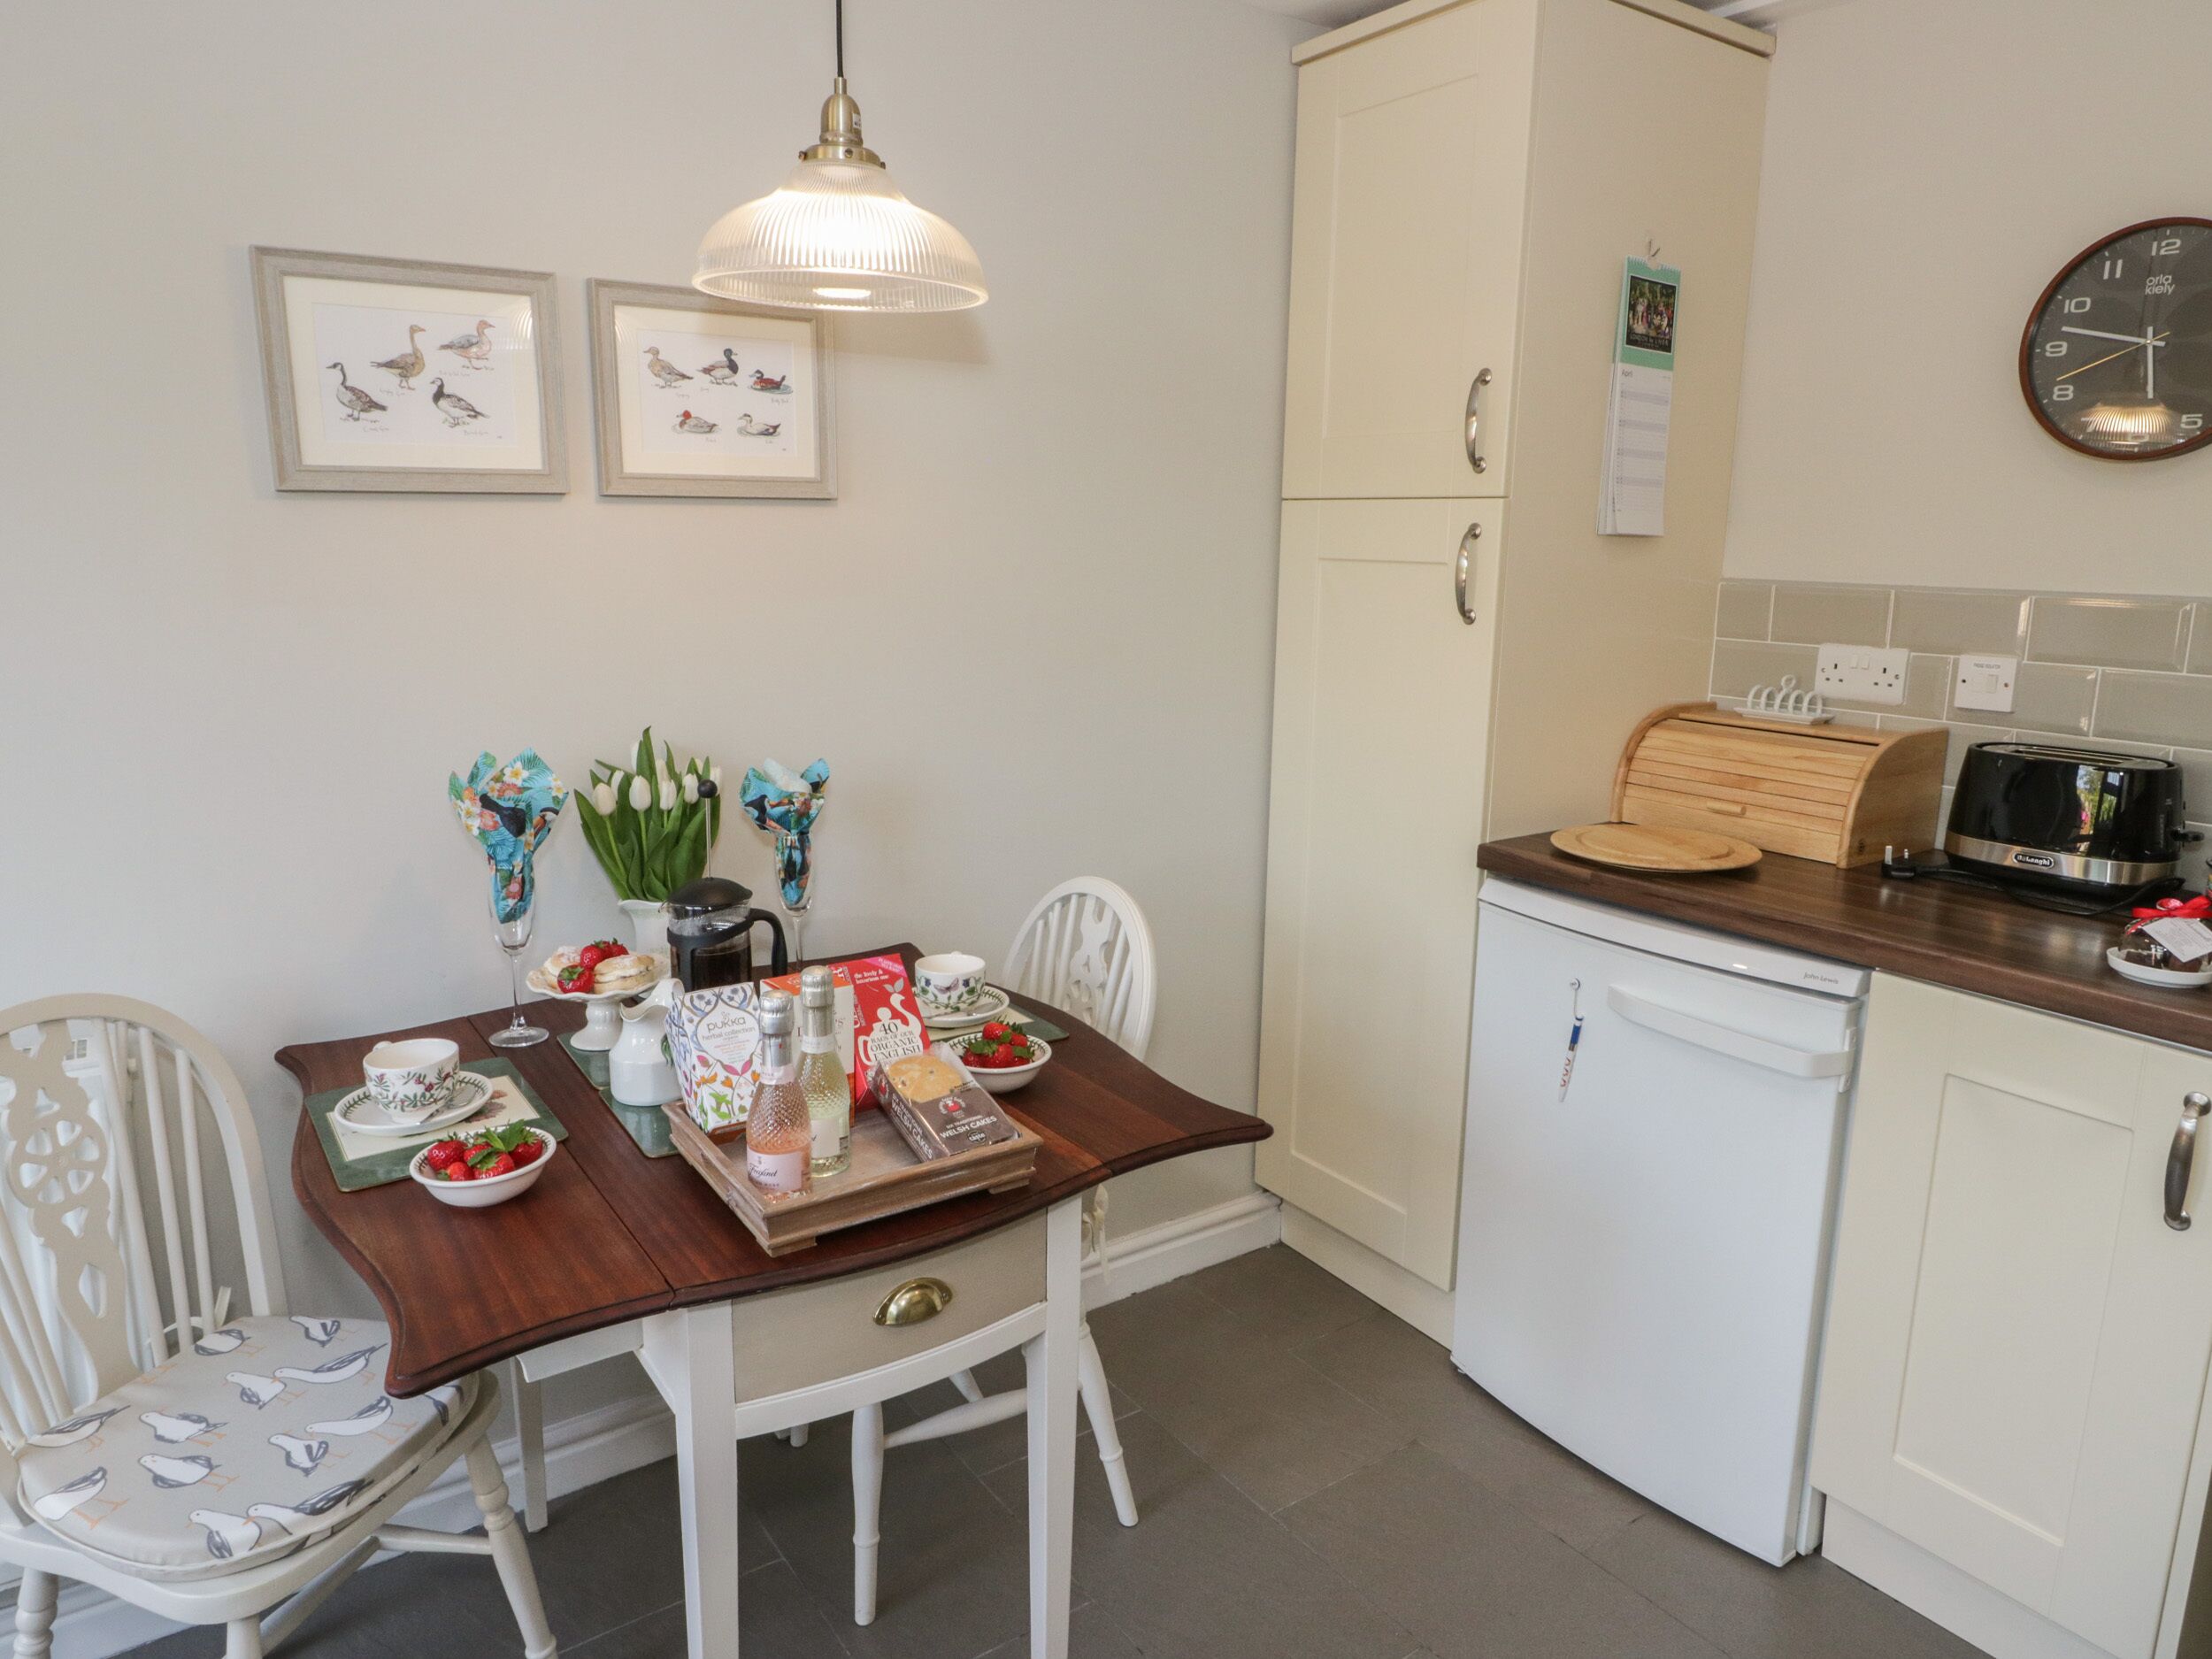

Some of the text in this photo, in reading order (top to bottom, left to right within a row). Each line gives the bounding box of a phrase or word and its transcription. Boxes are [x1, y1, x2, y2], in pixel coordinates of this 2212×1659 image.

[2151, 239, 2181, 257] 12
[2103, 259, 2123, 280] 11
[2146, 273, 2172, 285] orla
[2145, 282, 2176, 296] kiely
[2063, 297, 2091, 313] 10
[2046, 342, 2068, 357] 9
[1621, 369, 1633, 379] April
[2053, 385, 2074, 400] 8
[2081, 417, 2096, 433] 7
[2180, 414, 2203, 428] 5
[1803, 972, 1839, 984] John Lewis
[707, 1015, 746, 1033] pukka
[879, 1021, 899, 1035] 40
[702, 1026, 756, 1041] herbal collection
[871, 1035, 889, 1044] BAGS
[870, 1037, 919, 1052] ORGANIC
[873, 1044, 922, 1062] ENGLISH
[891, 1098, 912, 1132] WELSH
[912, 1128, 933, 1160] CAKES
[939, 1115, 997, 1139] WELSH CAKES
